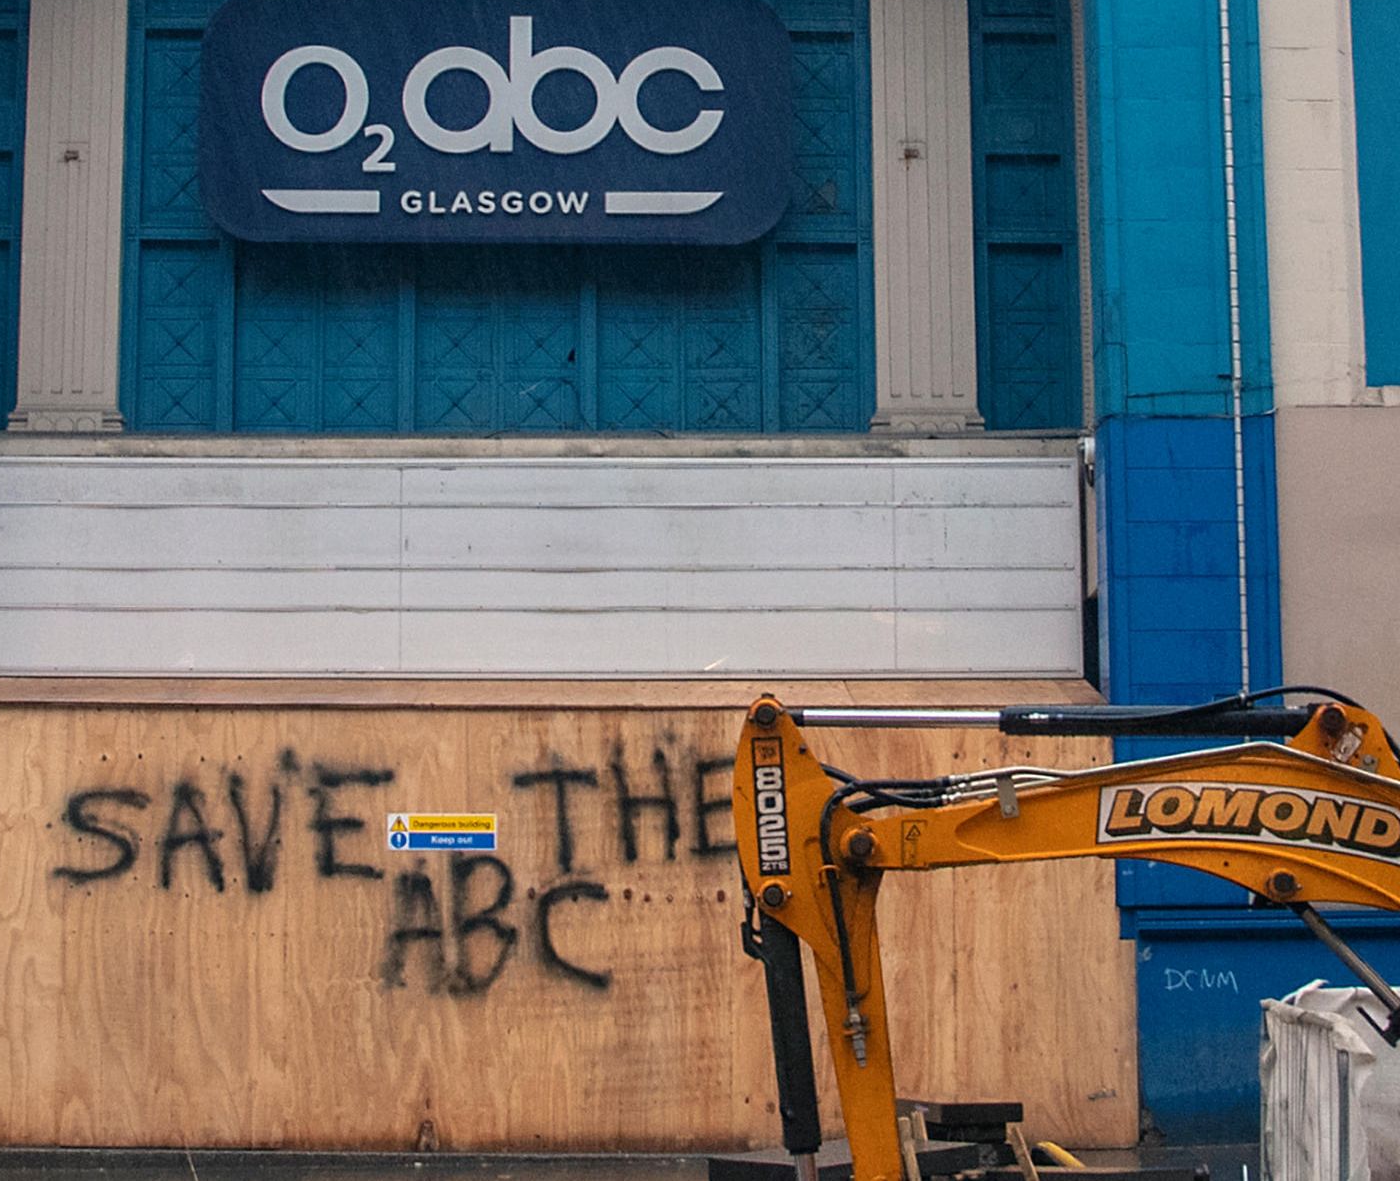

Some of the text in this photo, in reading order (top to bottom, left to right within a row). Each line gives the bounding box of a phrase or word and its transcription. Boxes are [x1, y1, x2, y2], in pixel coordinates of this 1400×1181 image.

[402, 15, 725, 155] abc
[400, 190, 590, 215] GLASGOW
[51, 736, 738, 894] SAVE THE
[412, 819, 491, 830] Dangerous building
[430, 835, 473, 845] Keep out
[755, 766, 788, 862] 8025
[380, 855, 610, 995] ABC
